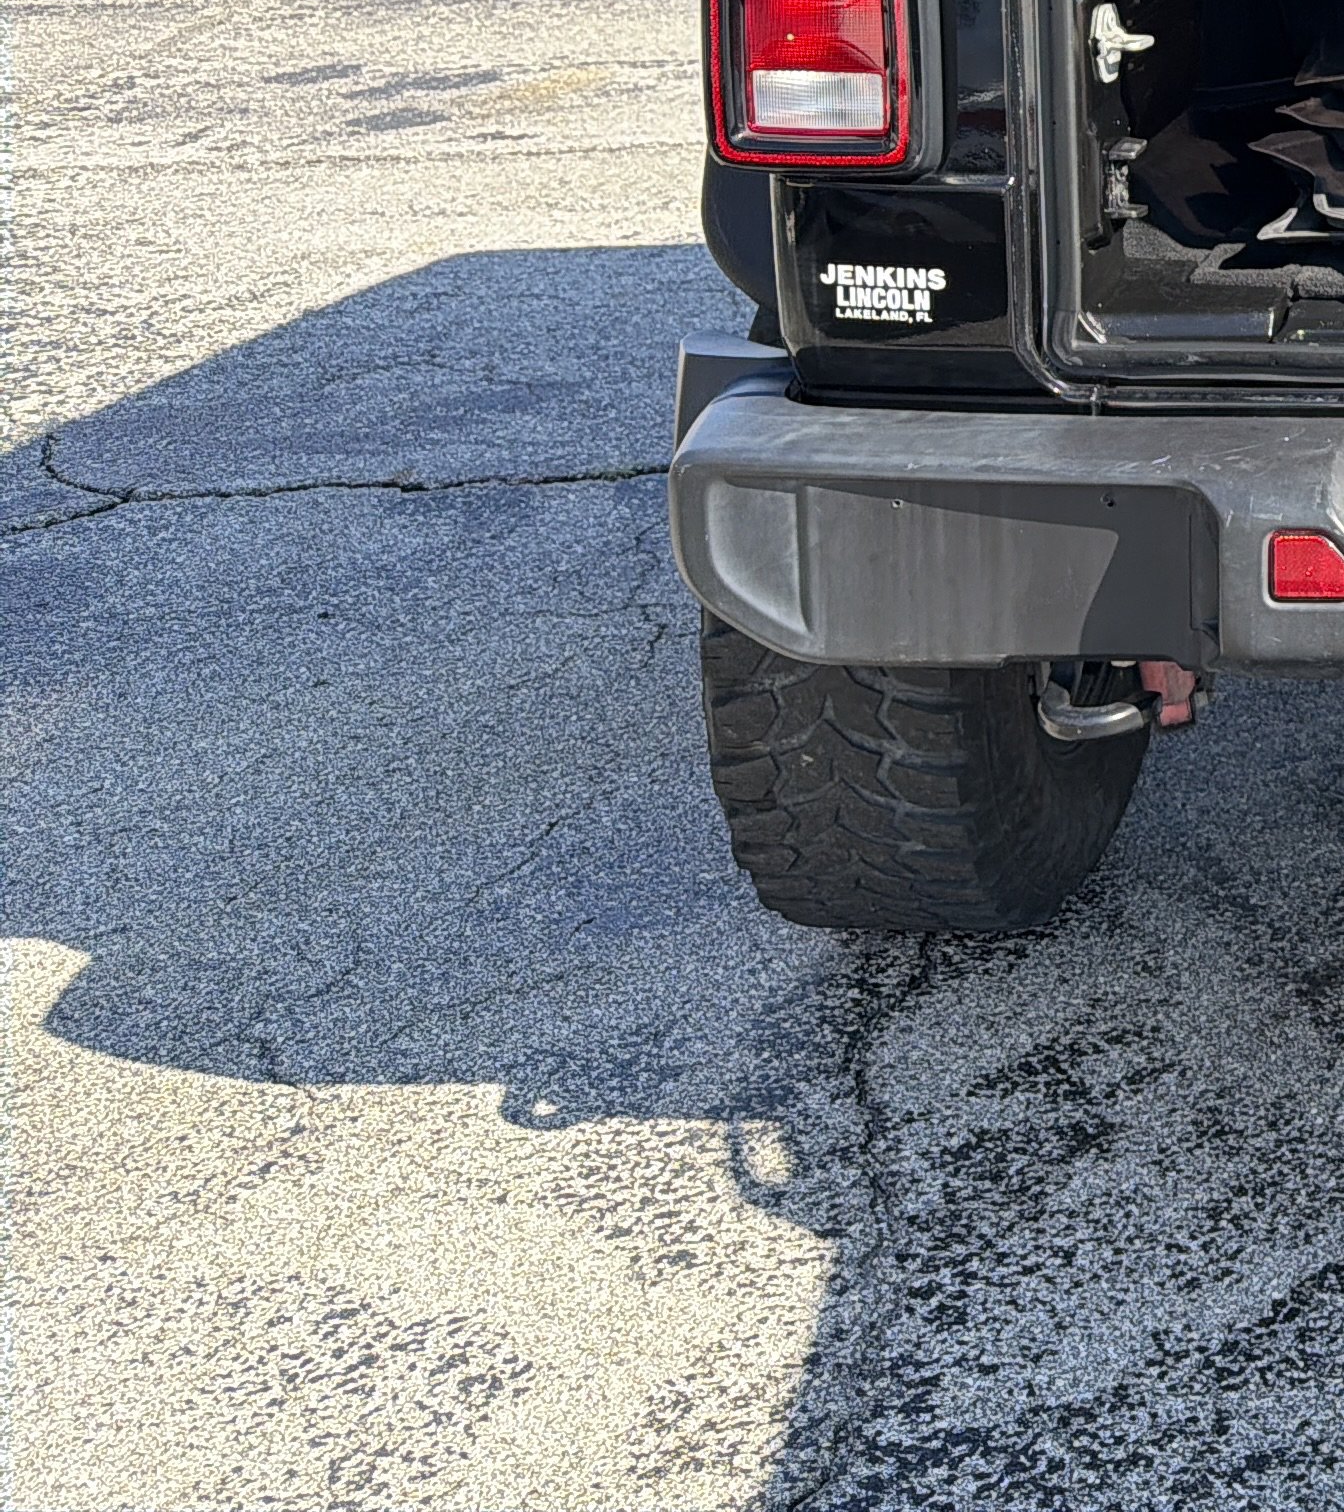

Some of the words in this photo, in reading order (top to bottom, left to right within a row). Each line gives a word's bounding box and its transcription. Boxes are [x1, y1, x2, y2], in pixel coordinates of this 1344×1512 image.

[819, 263, 947, 291] JENKINS
[836, 286, 931, 311] LINCOLN
[835, 307, 914, 324] LAKELAND,
[915, 311, 933, 323] FL
